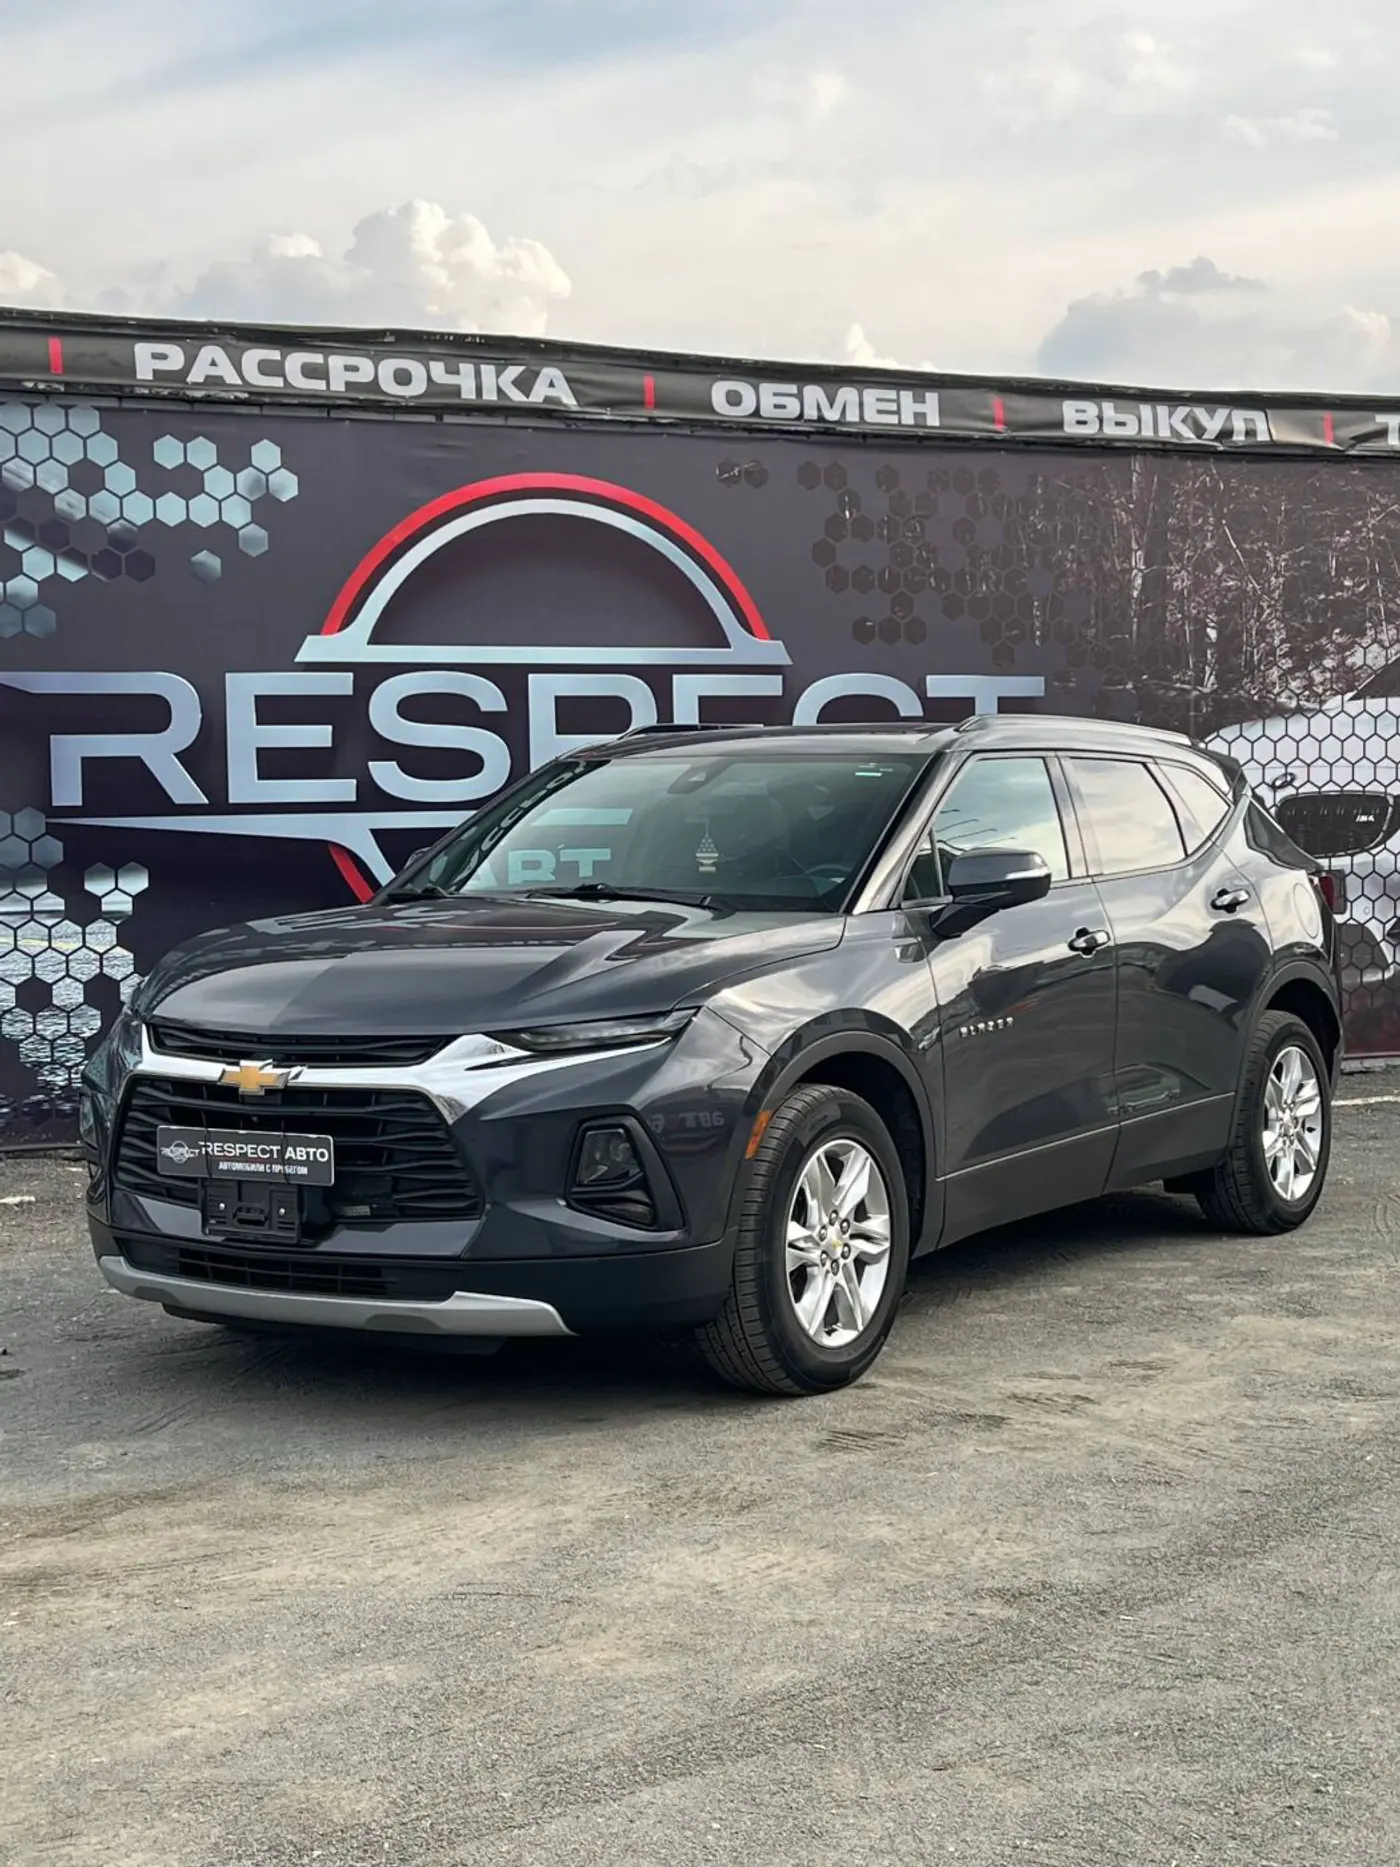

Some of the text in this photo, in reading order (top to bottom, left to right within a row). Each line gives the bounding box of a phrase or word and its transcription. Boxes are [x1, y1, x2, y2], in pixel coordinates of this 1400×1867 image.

[134, 342, 578, 407] РАССРОЧКА
[710, 379, 941, 429] ОБМЕН
[1061, 400, 1272, 445] ВЫКУП
[960, 1016, 1014, 1038] BLAZER
[198, 1141, 281, 1159] RESPECT
